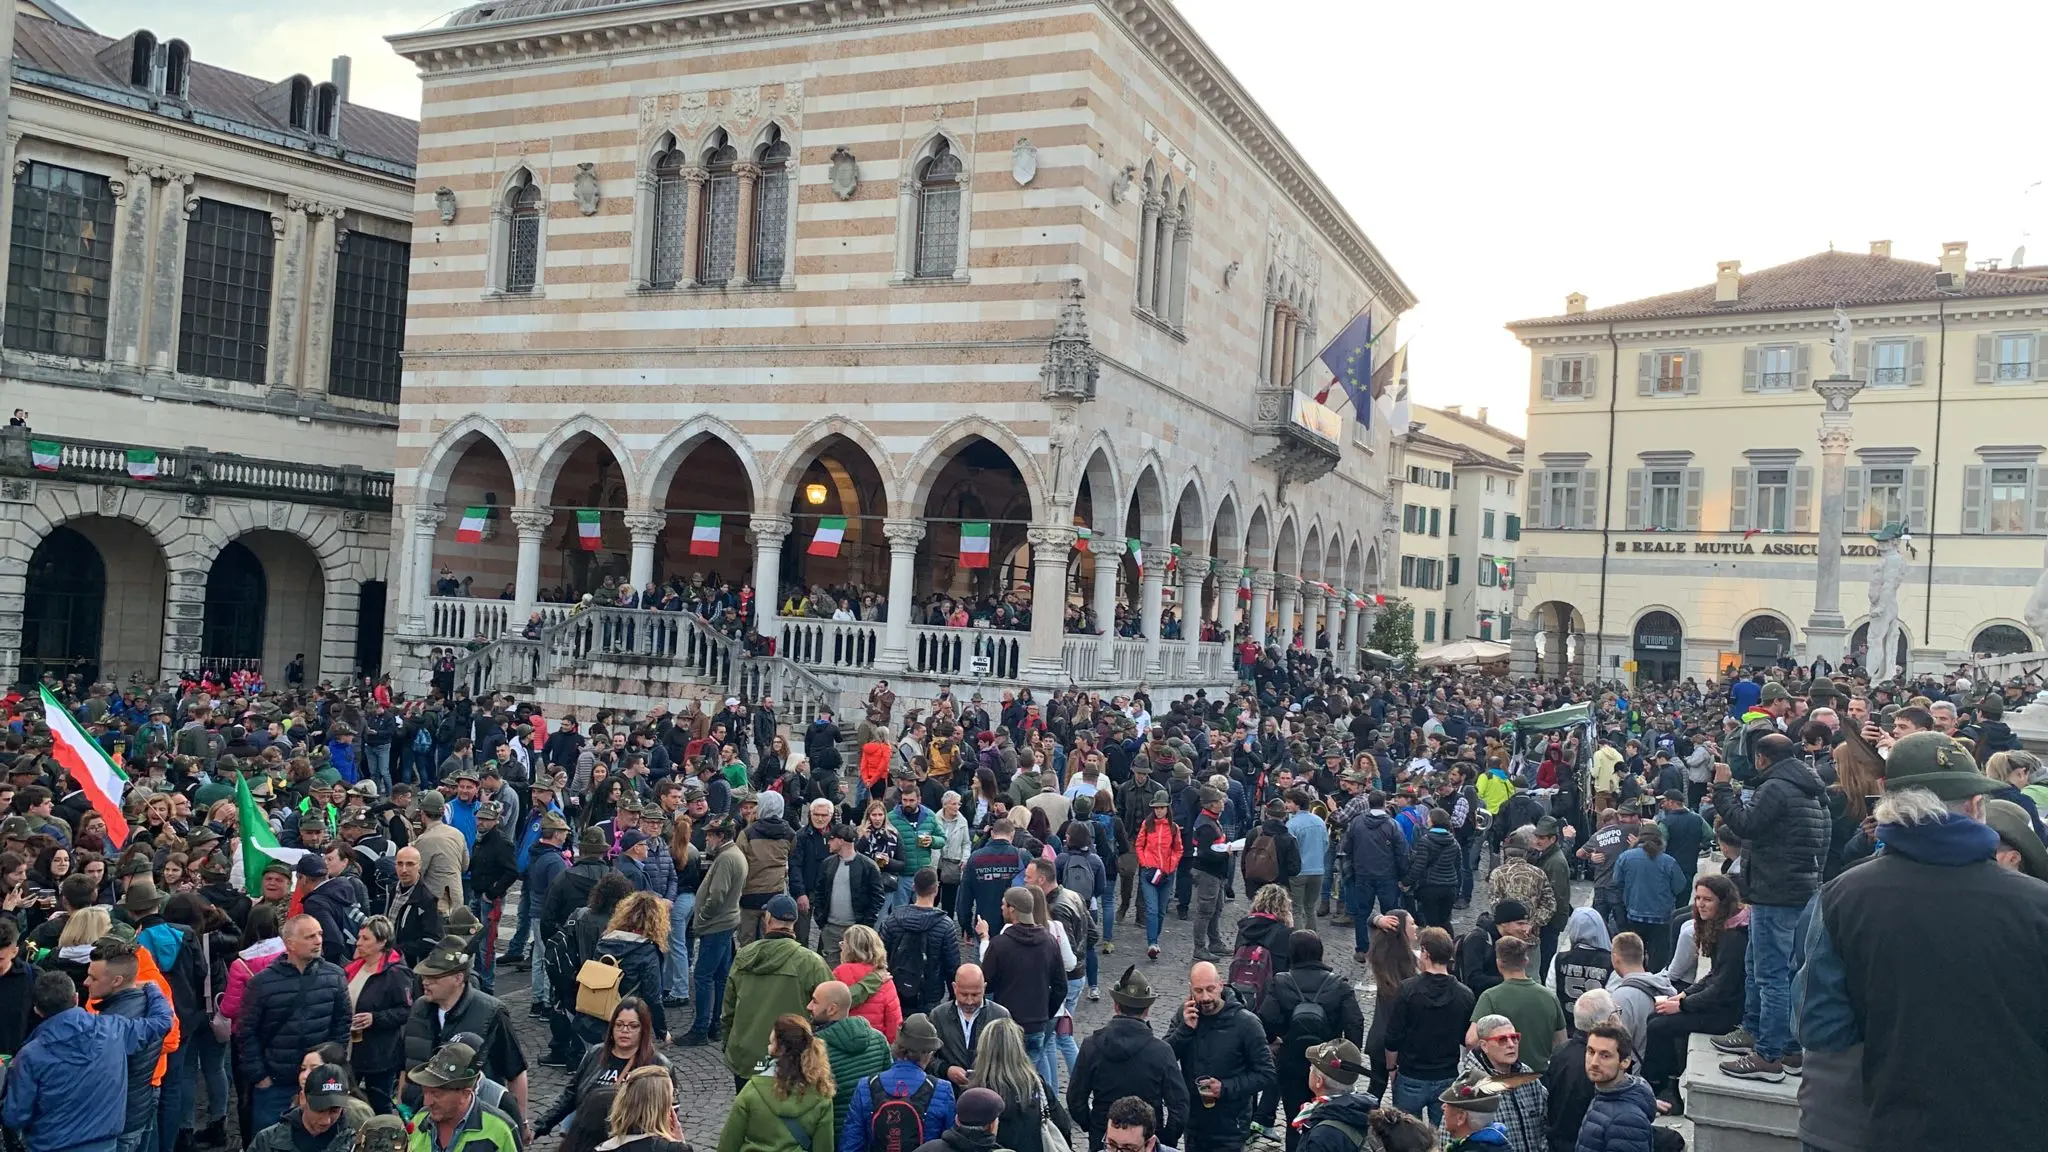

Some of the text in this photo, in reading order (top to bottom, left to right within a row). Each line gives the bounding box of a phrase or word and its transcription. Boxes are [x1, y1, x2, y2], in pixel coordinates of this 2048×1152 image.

[1632, 541, 1686, 553] REALE
[1695, 542, 1755, 554] MUTUA
[1640, 635, 1674, 645] METROPOLIS
[1597, 829, 1622, 841] GRUPPO
[1598, 836, 1621, 847] SOVER
[1560, 963, 1607, 980] NEW YORK
